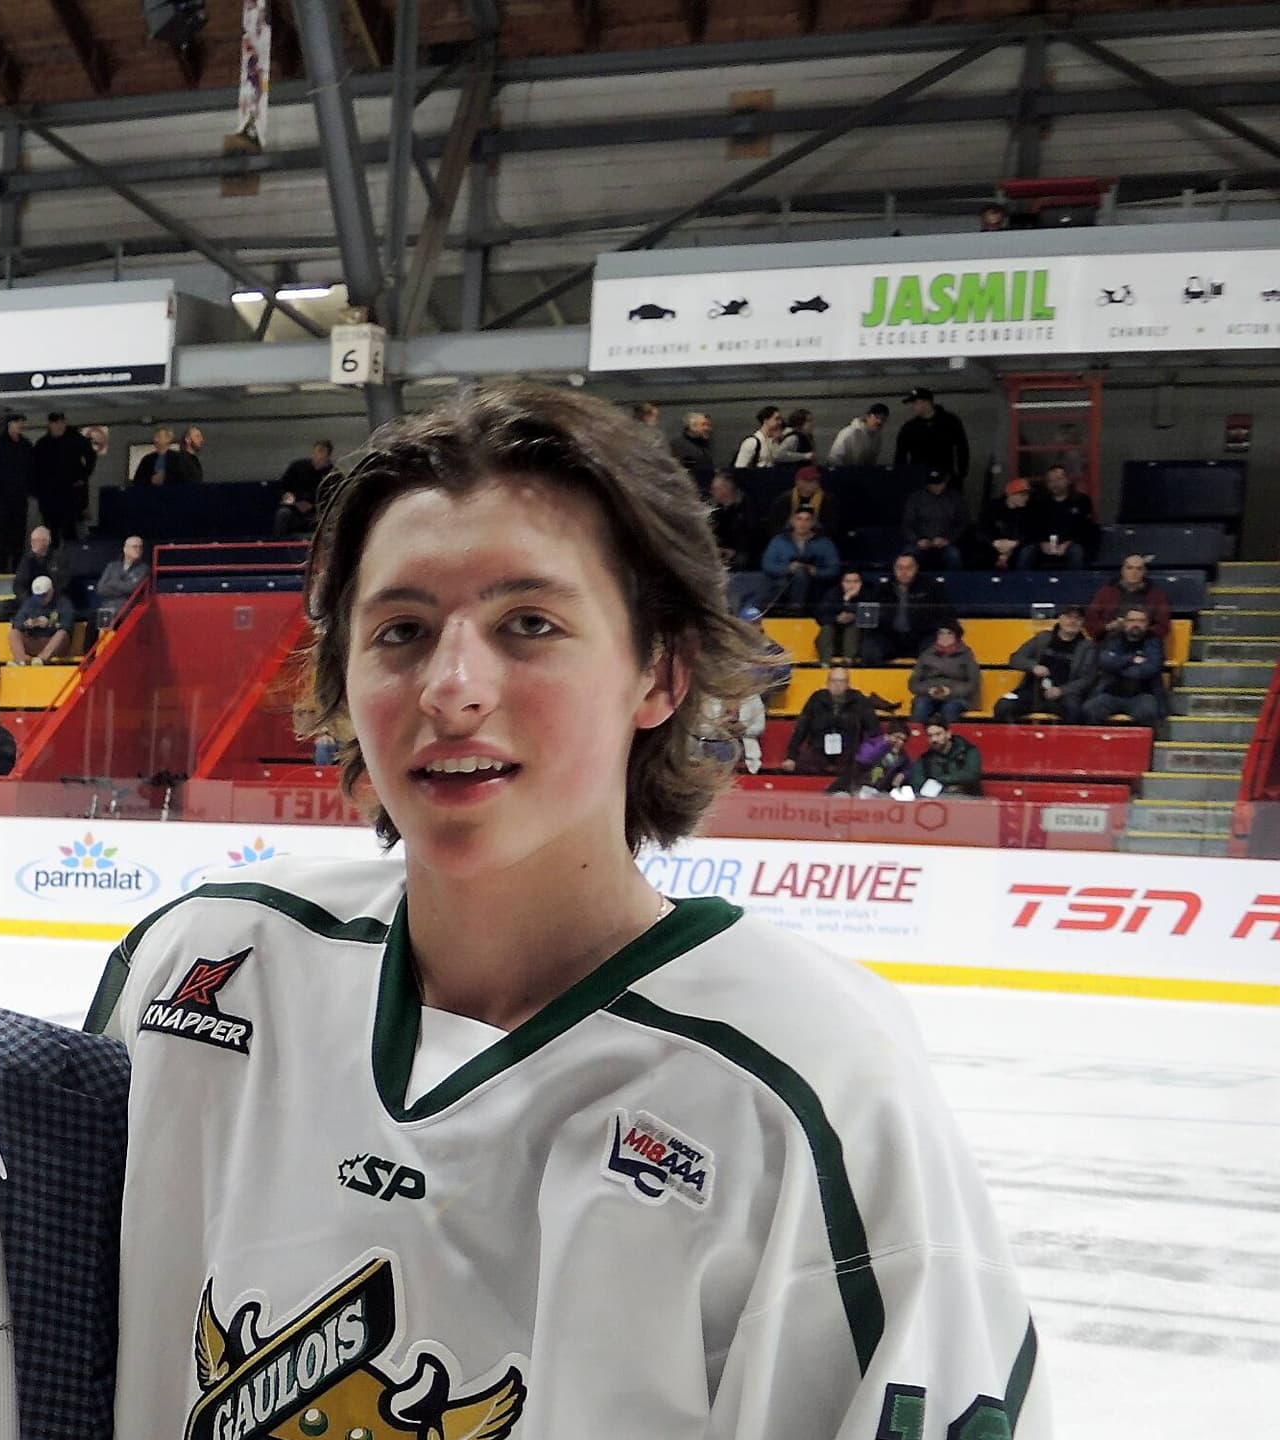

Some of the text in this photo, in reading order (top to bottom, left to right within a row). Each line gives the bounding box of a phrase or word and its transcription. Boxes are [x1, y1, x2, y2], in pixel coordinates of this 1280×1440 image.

[861, 269, 1056, 327] JASMIL
[342, 349, 359, 373] 6
[34, 868, 143, 892] parmalat
[640, 857, 743, 898] CTOR
[1008, 883, 1202, 936] TSN
[142, 1004, 246, 1046] KNAPPER
[345, 1155, 426, 1202] SP
